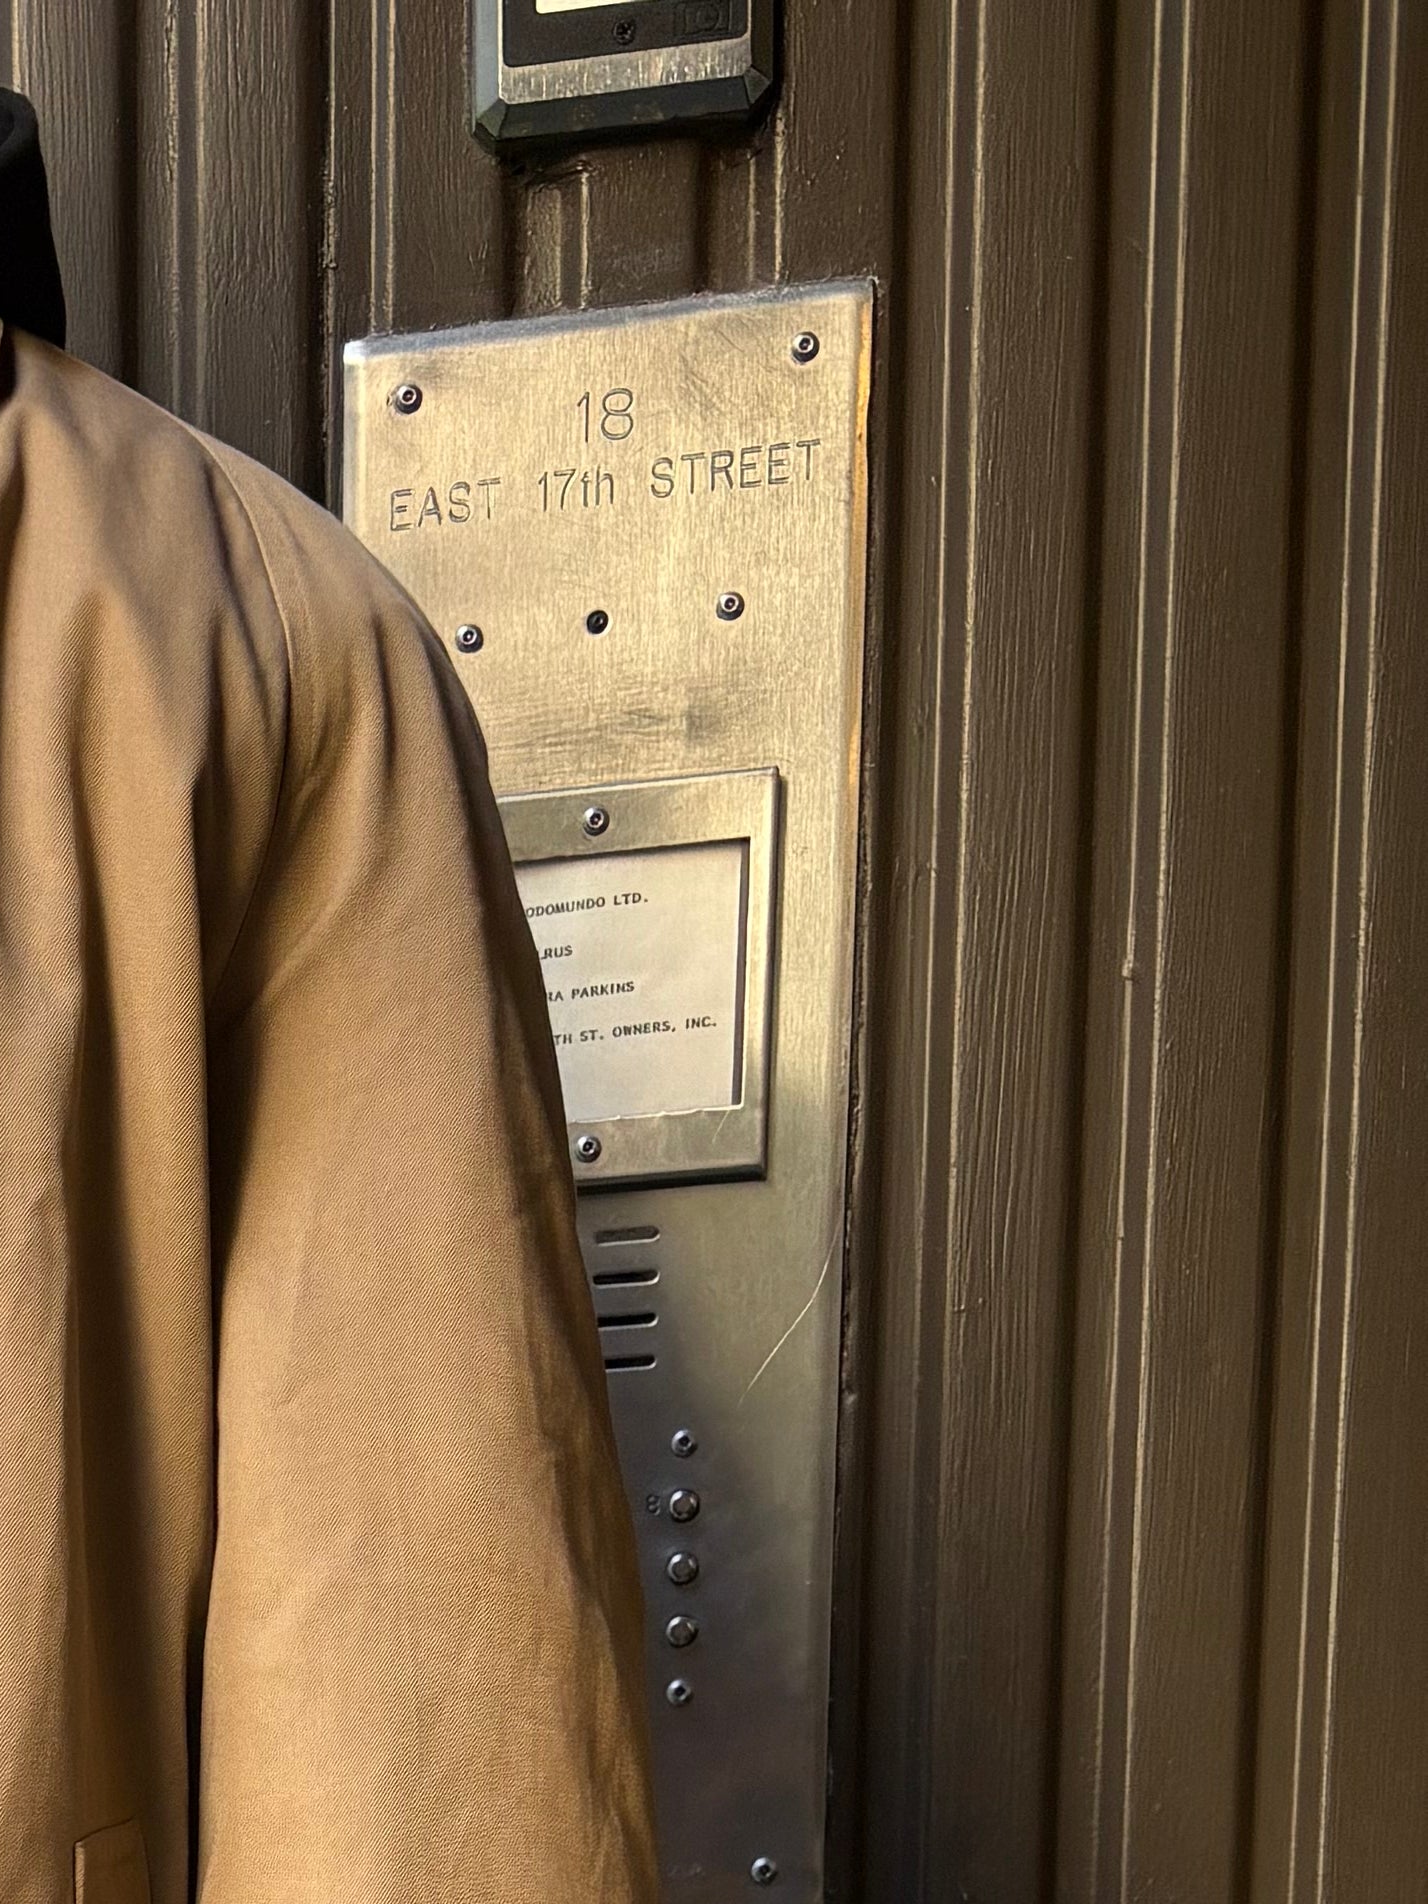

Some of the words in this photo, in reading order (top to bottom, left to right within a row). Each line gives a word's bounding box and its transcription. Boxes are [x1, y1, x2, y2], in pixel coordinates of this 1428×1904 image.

[576, 387, 635, 443] 18
[388, 477, 502, 532] EAST
[537, 464, 615, 512] 17th
[650, 438, 822, 499] STREET
[613, 892, 649, 906] LTD.
[571, 981, 635, 1001] PARKINS
[579, 1029, 604, 1042] ST.
[612, 1020, 676, 1039] OWNERS,
[685, 1016, 717, 1030] INC.
